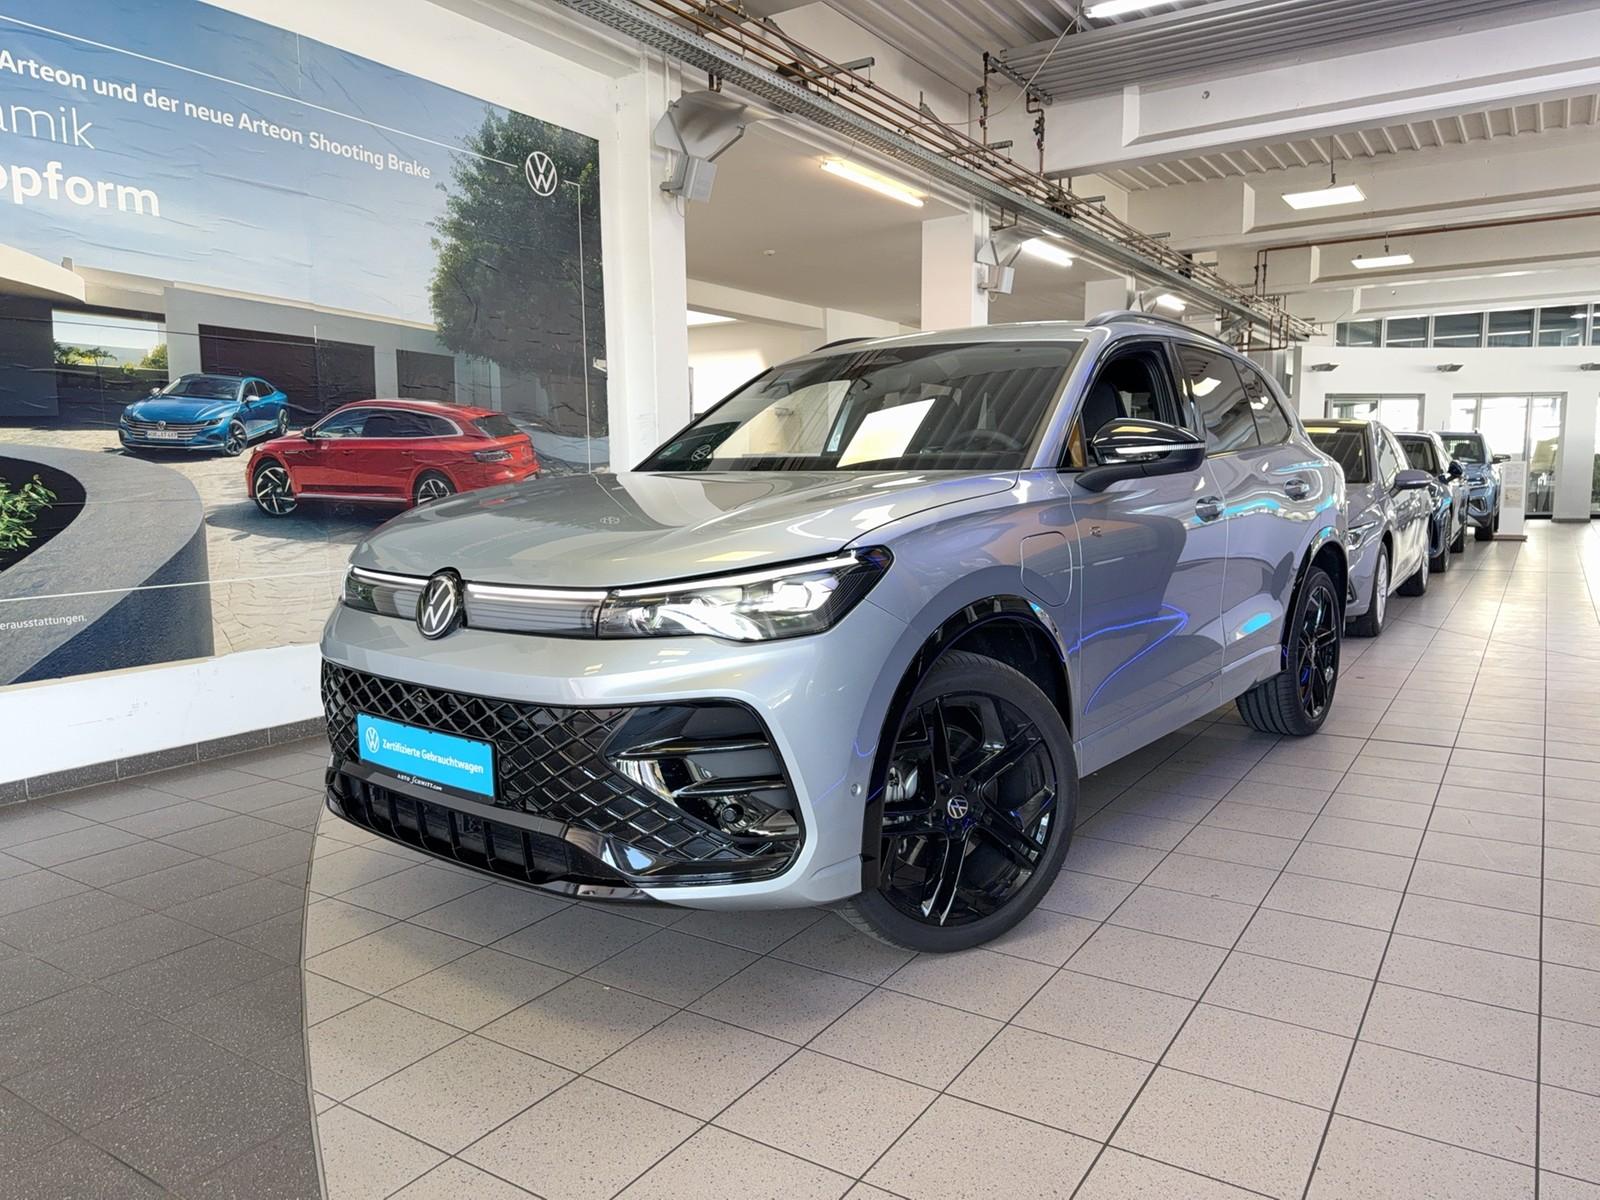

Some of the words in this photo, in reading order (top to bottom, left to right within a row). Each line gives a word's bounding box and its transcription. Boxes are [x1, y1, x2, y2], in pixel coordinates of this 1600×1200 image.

[0, 50, 87, 90] Arteon
[93, 78, 138, 104] und
[143, 89, 180, 113] der
[184, 101, 235, 128] neue
[238, 112, 303, 145] Arteon
[309, 132, 384, 170] Shooting
[388, 153, 431, 179] Brake
[0, 161, 161, 217] pform
[381, 739, 421, 759] Zertifizierte
[421, 749, 484, 774] Gebrauchtwagen
